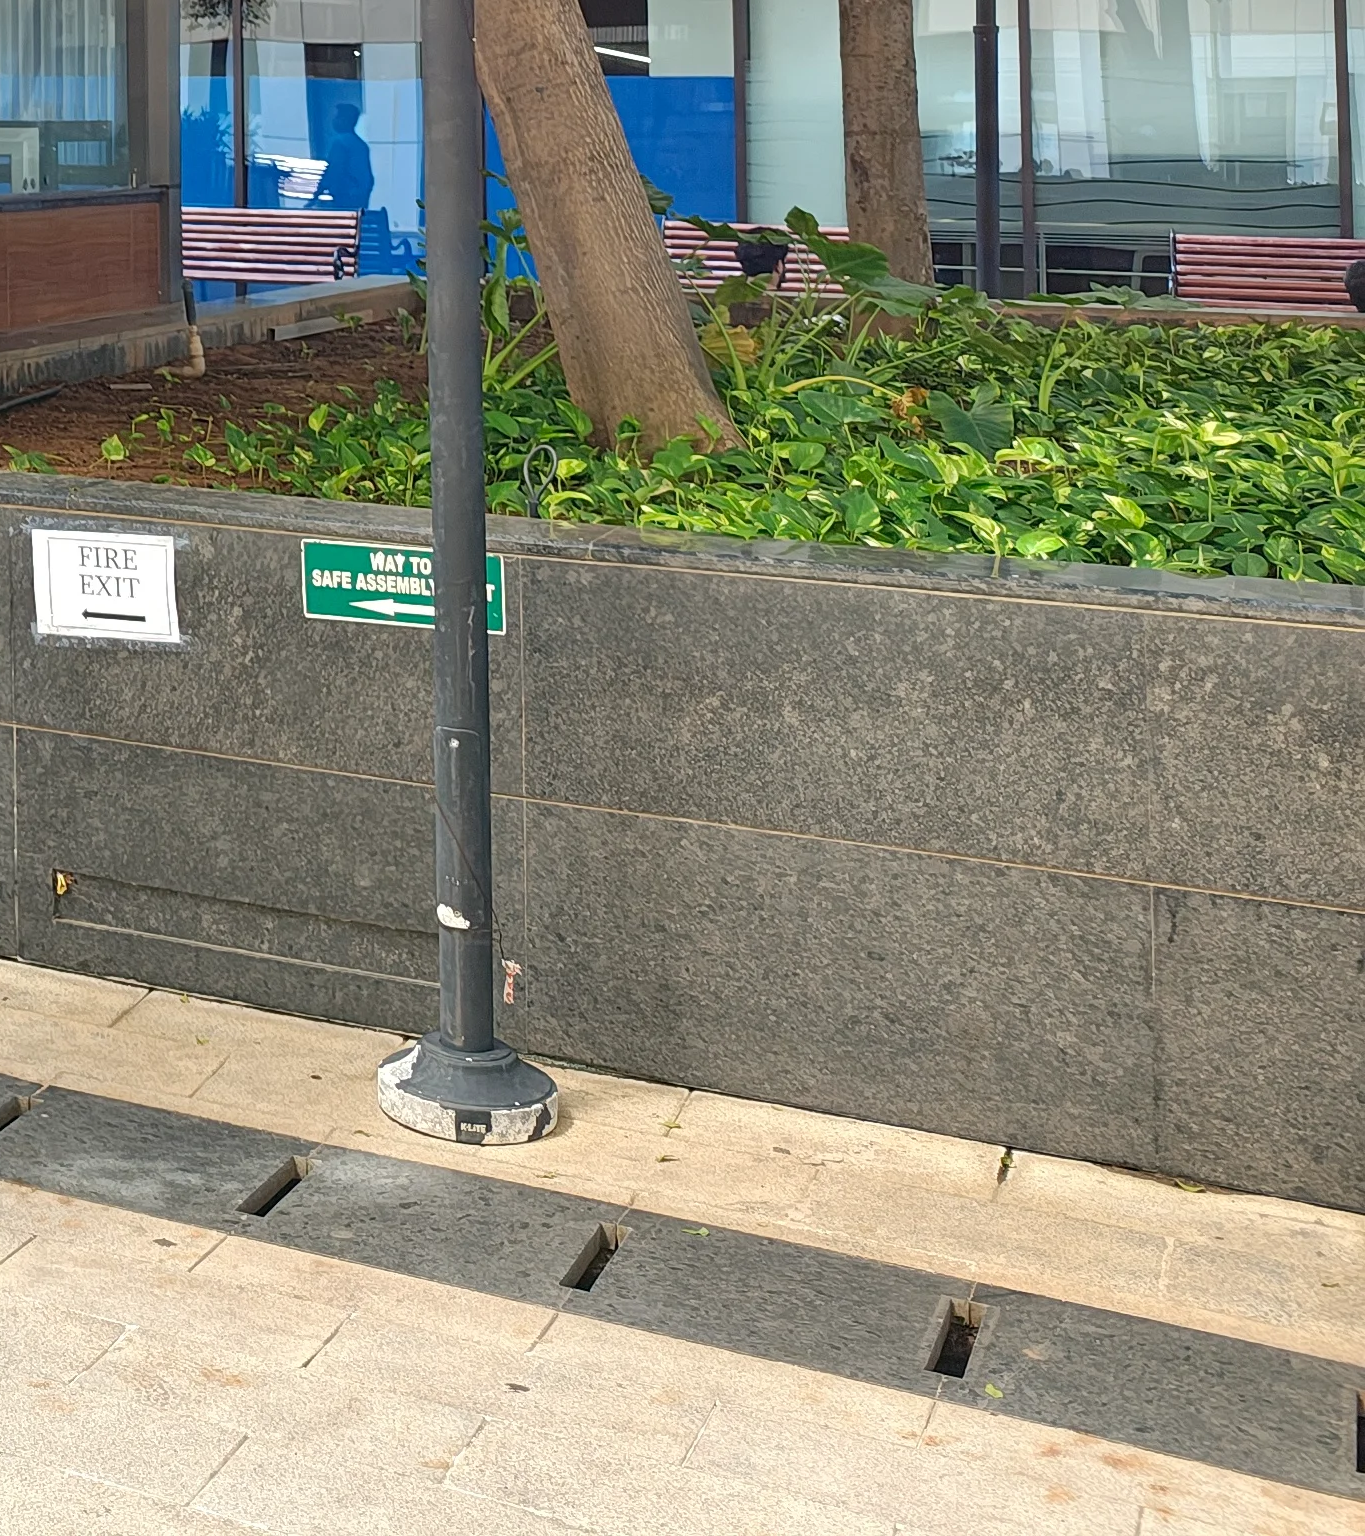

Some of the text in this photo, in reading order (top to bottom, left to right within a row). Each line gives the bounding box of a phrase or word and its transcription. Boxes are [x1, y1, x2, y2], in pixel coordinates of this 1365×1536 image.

[78, 545, 138, 570] FIRE
[370, 551, 432, 575] WAY TO
[79, 573, 140, 598] EXIT
[312, 569, 352, 589] SAFE
